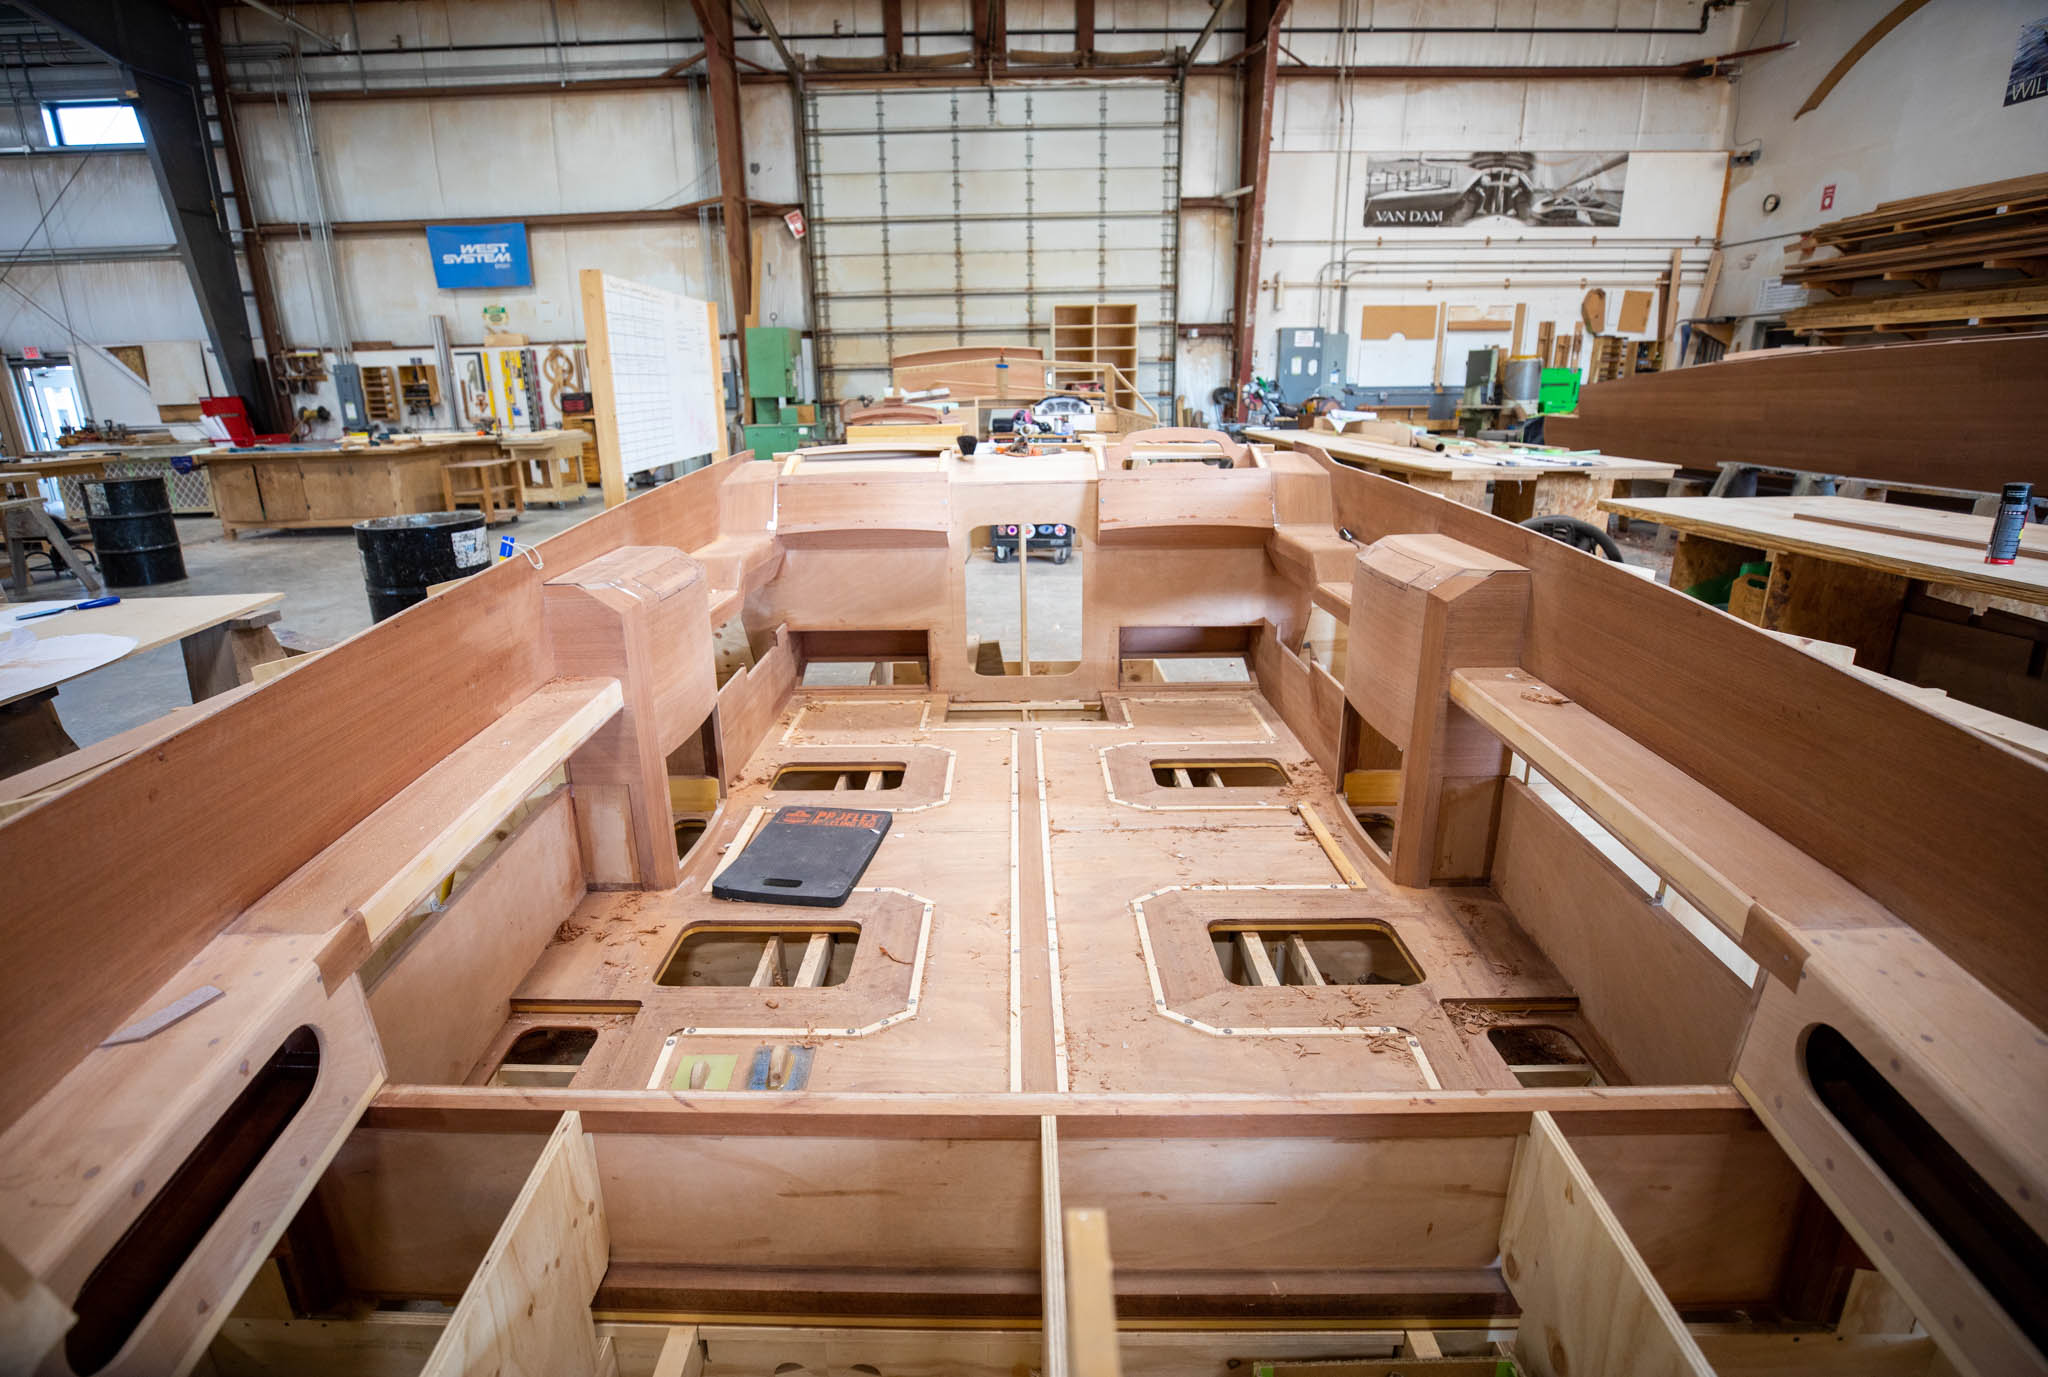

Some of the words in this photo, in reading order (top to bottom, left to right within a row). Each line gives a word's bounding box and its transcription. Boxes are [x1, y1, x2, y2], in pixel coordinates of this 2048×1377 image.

[2012, 77, 2048, 101] WIL
[1375, 210, 1406, 222] VAN
[1409, 210, 1443, 222] DAM
[460, 243, 509, 253] WEST
[443, 253, 511, 264] SYSTEM
